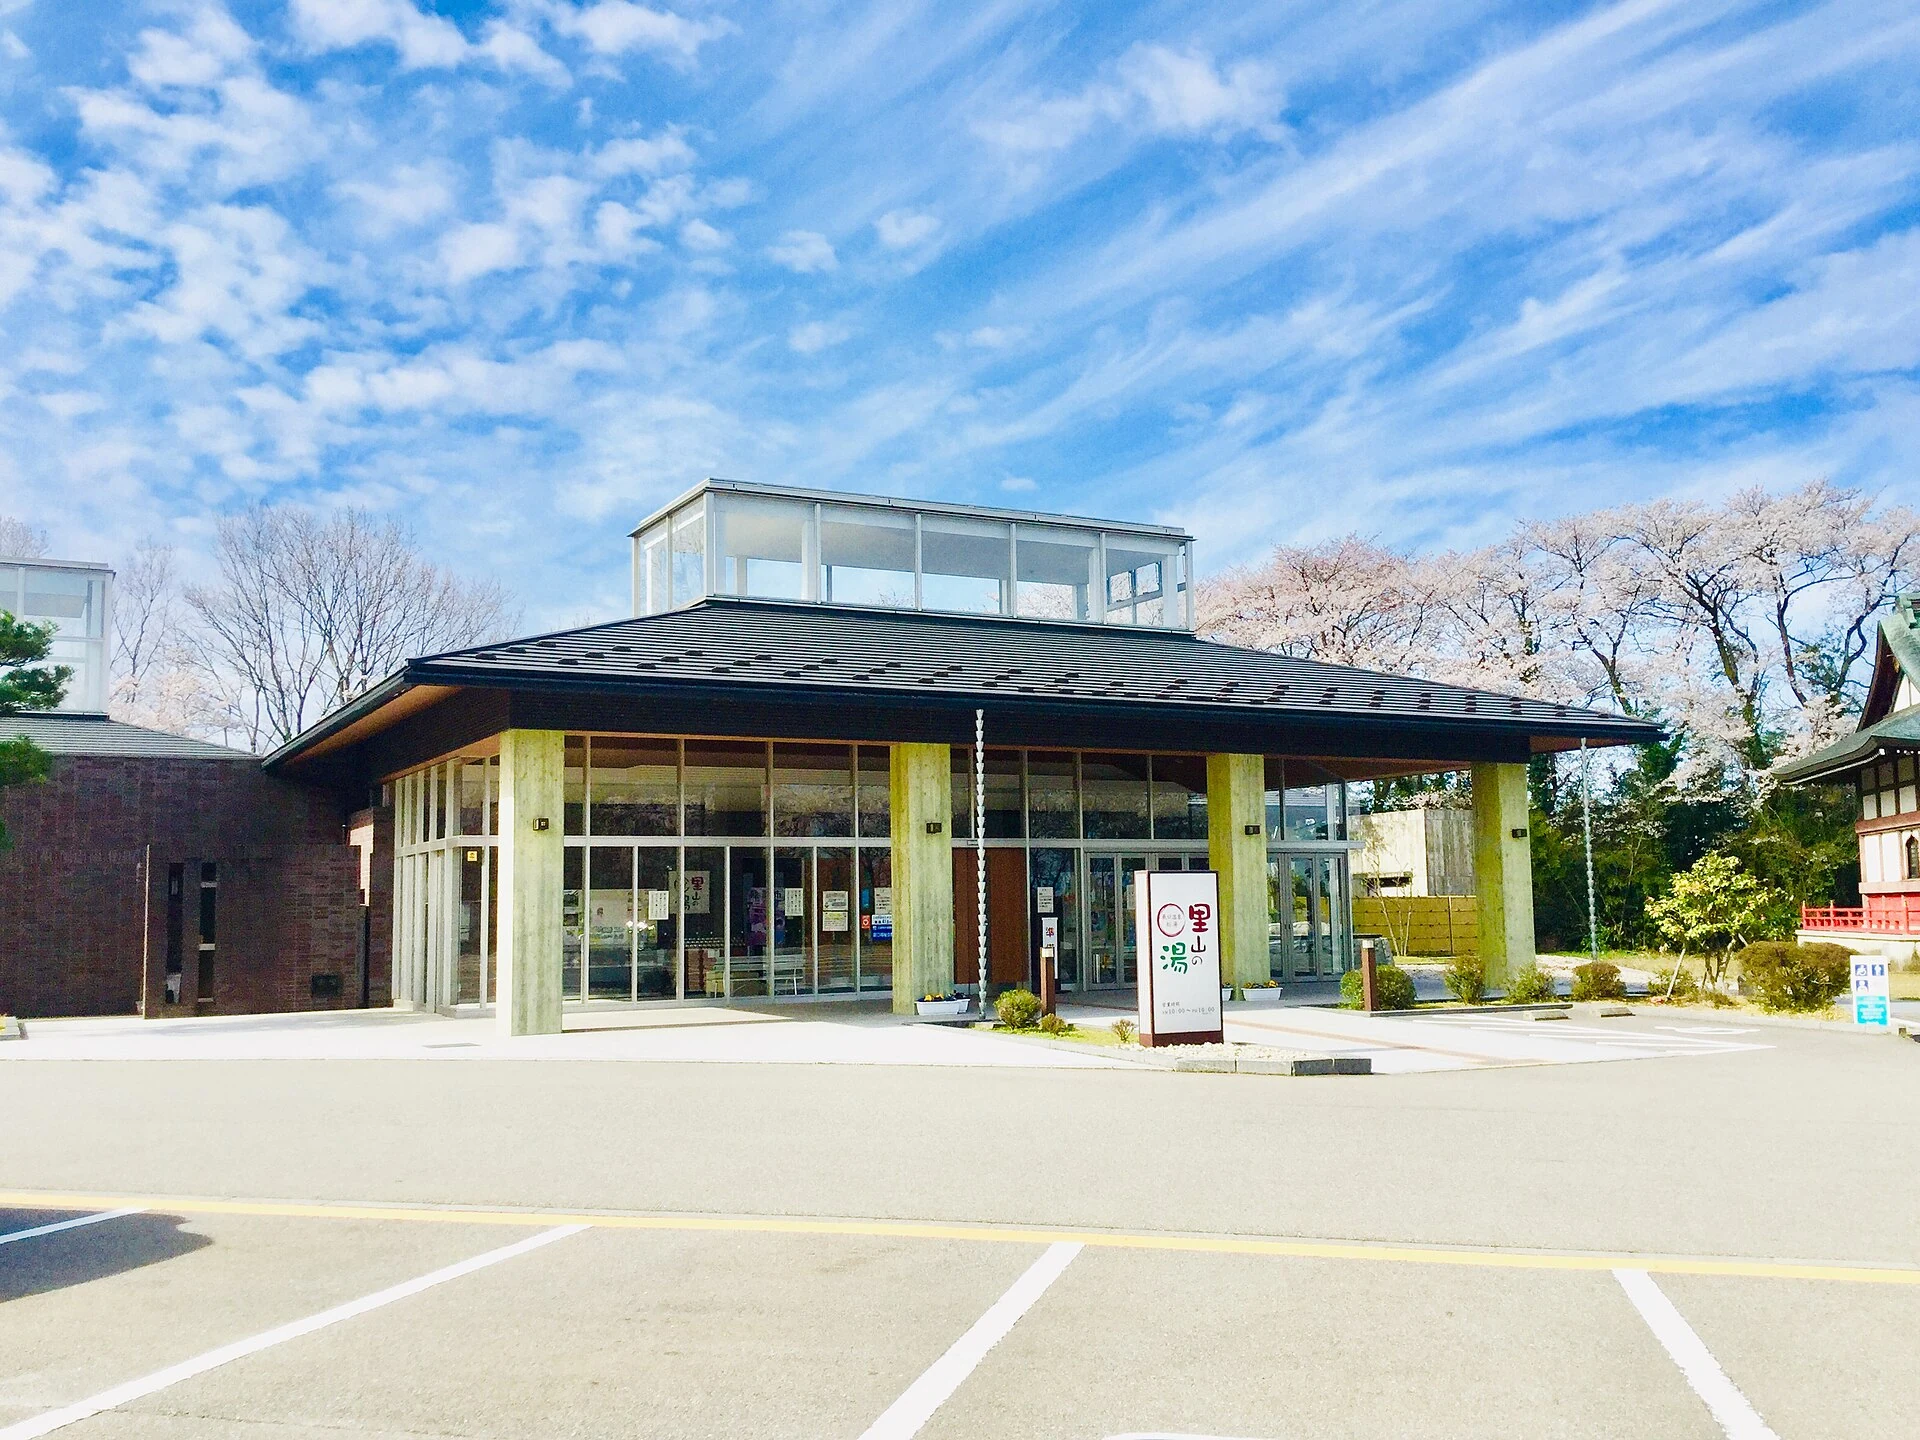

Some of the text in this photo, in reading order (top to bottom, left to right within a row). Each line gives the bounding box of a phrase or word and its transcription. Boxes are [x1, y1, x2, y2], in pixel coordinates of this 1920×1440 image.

[1189, 903, 1211, 965] 里山の
[1160, 942, 1188, 974] 湯
